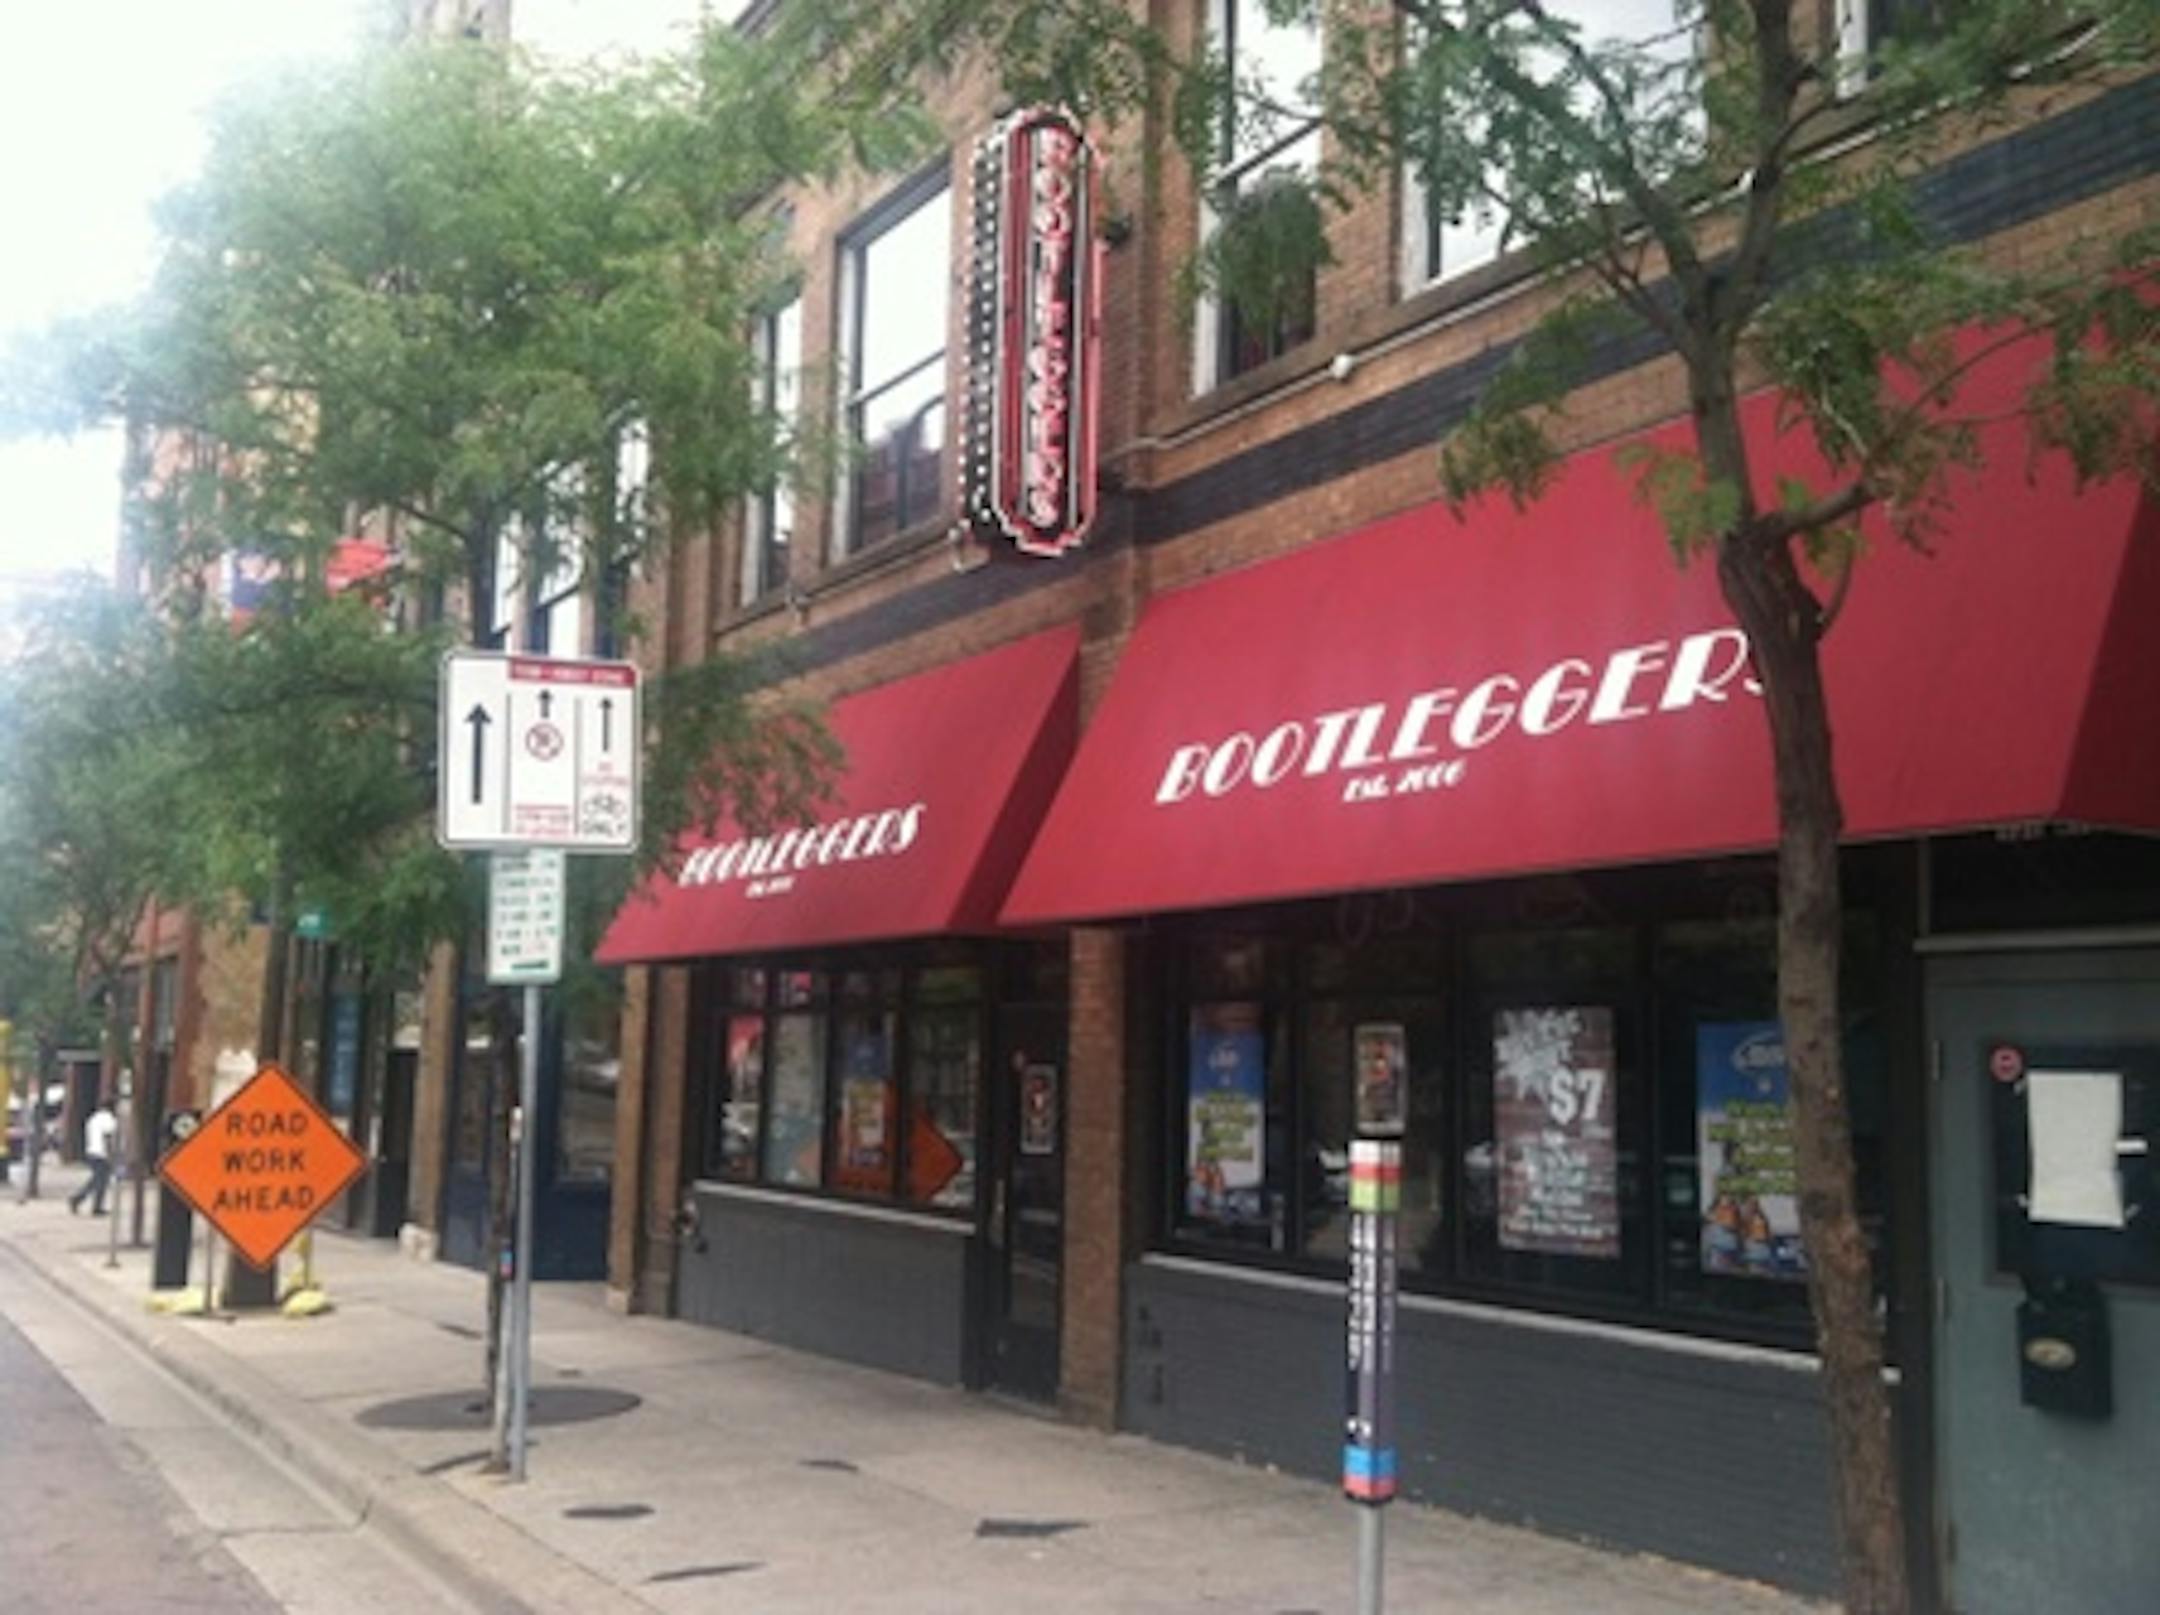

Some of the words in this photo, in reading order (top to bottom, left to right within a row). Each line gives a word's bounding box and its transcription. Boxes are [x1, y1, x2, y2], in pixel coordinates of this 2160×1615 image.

[1156, 628, 1764, 803] BOOTLEGGER
[1550, 1065, 1605, 1125] $7
[226, 1112, 308, 1137] ROAD
[222, 1149, 306, 1174] WORK
[211, 1185, 315, 1212] AHEAD
